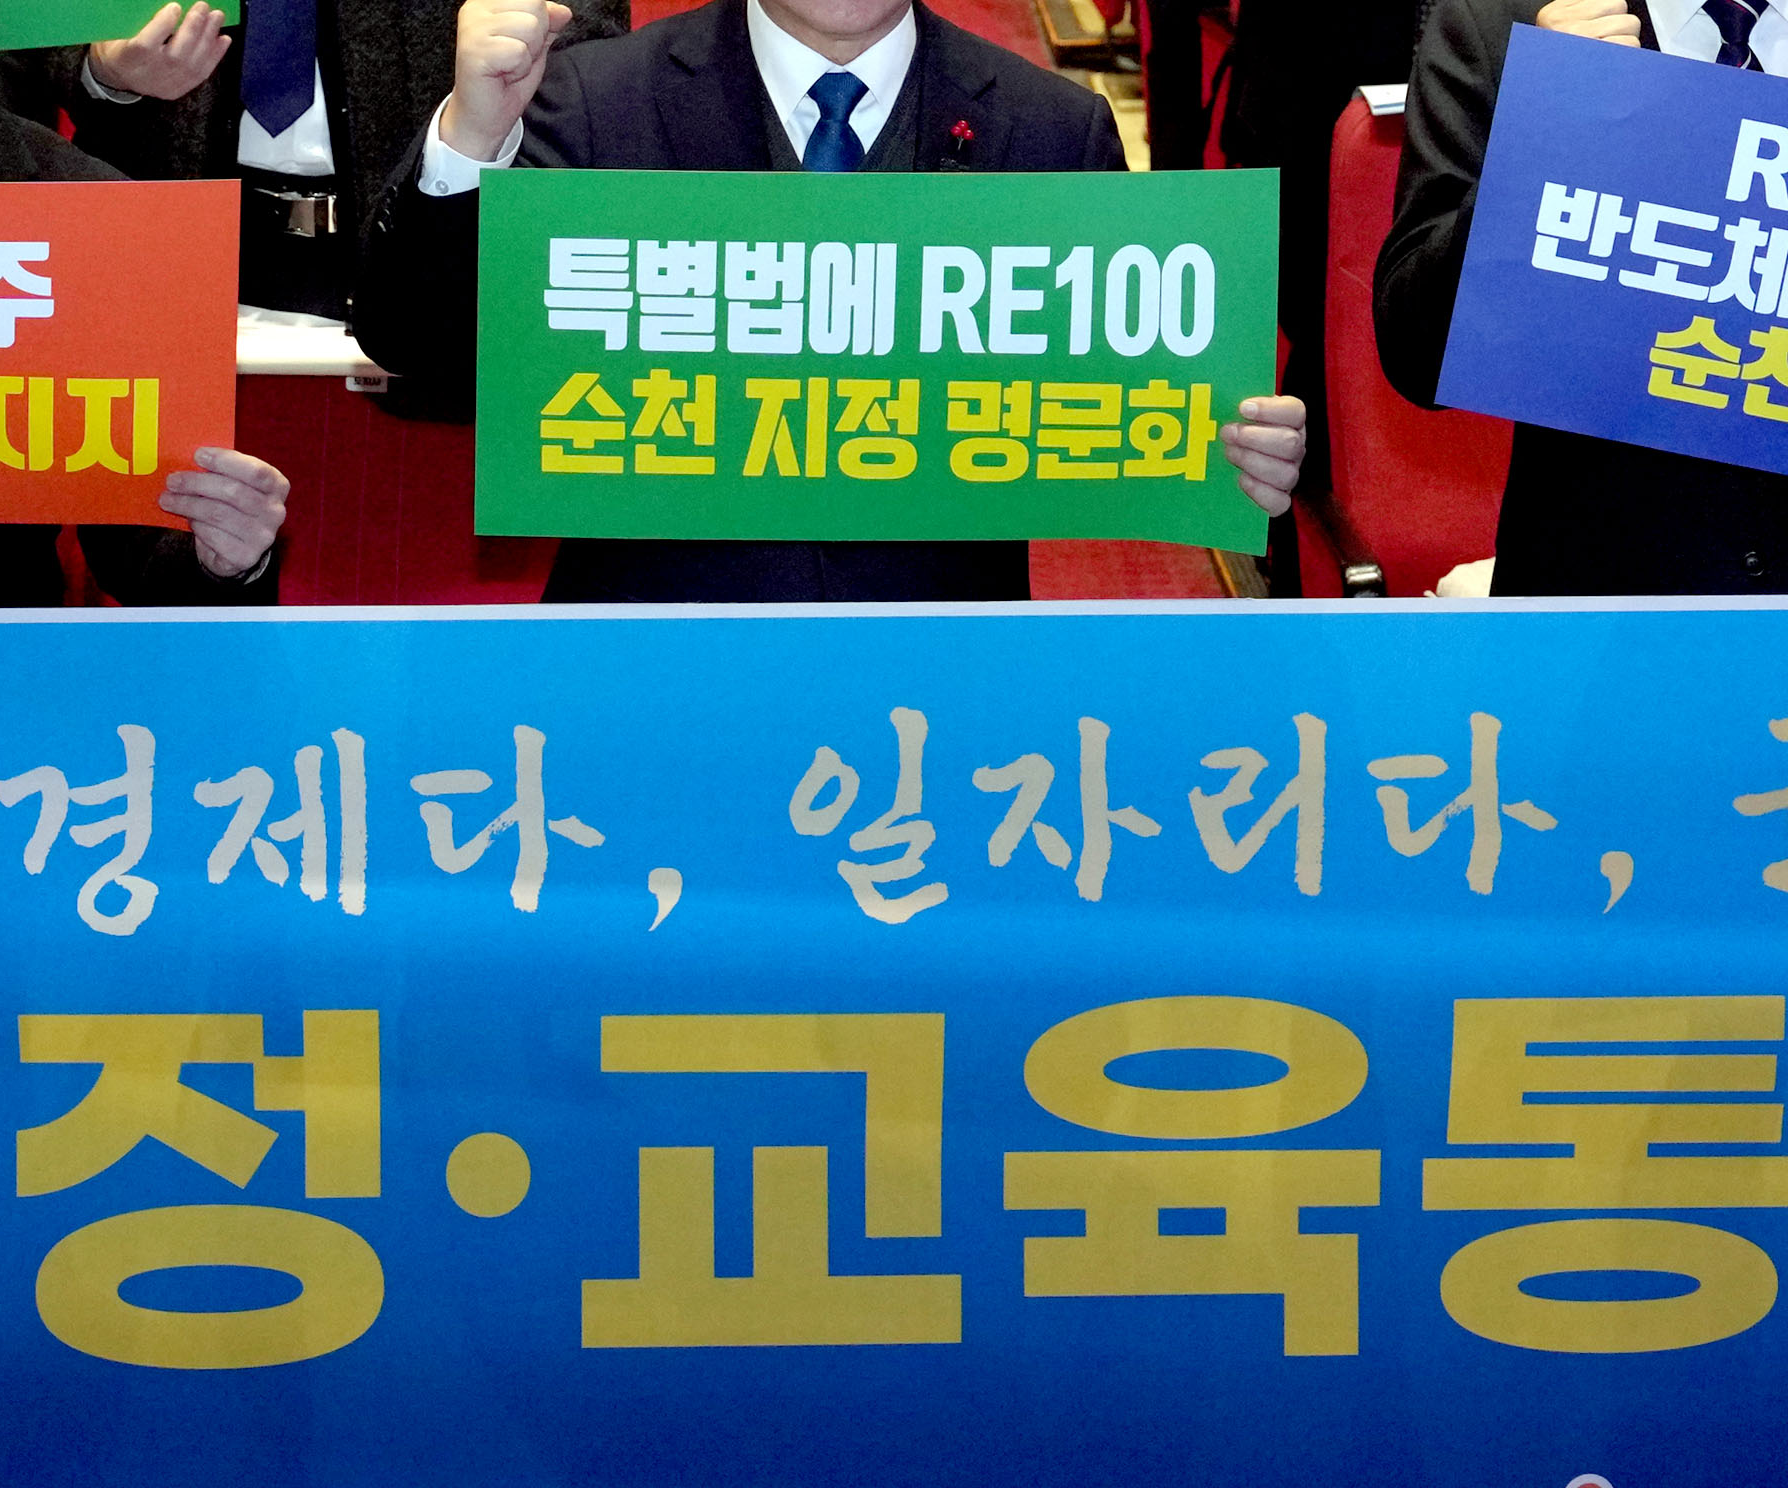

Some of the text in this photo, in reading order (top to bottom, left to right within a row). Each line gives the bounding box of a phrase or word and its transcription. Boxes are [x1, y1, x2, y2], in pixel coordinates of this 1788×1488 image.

[543, 237, 1215, 357] 특별법에 RE100
[540, 369, 1217, 482] 순천 지정 명문화
[788, 706, 1636, 924] 일자리다,
